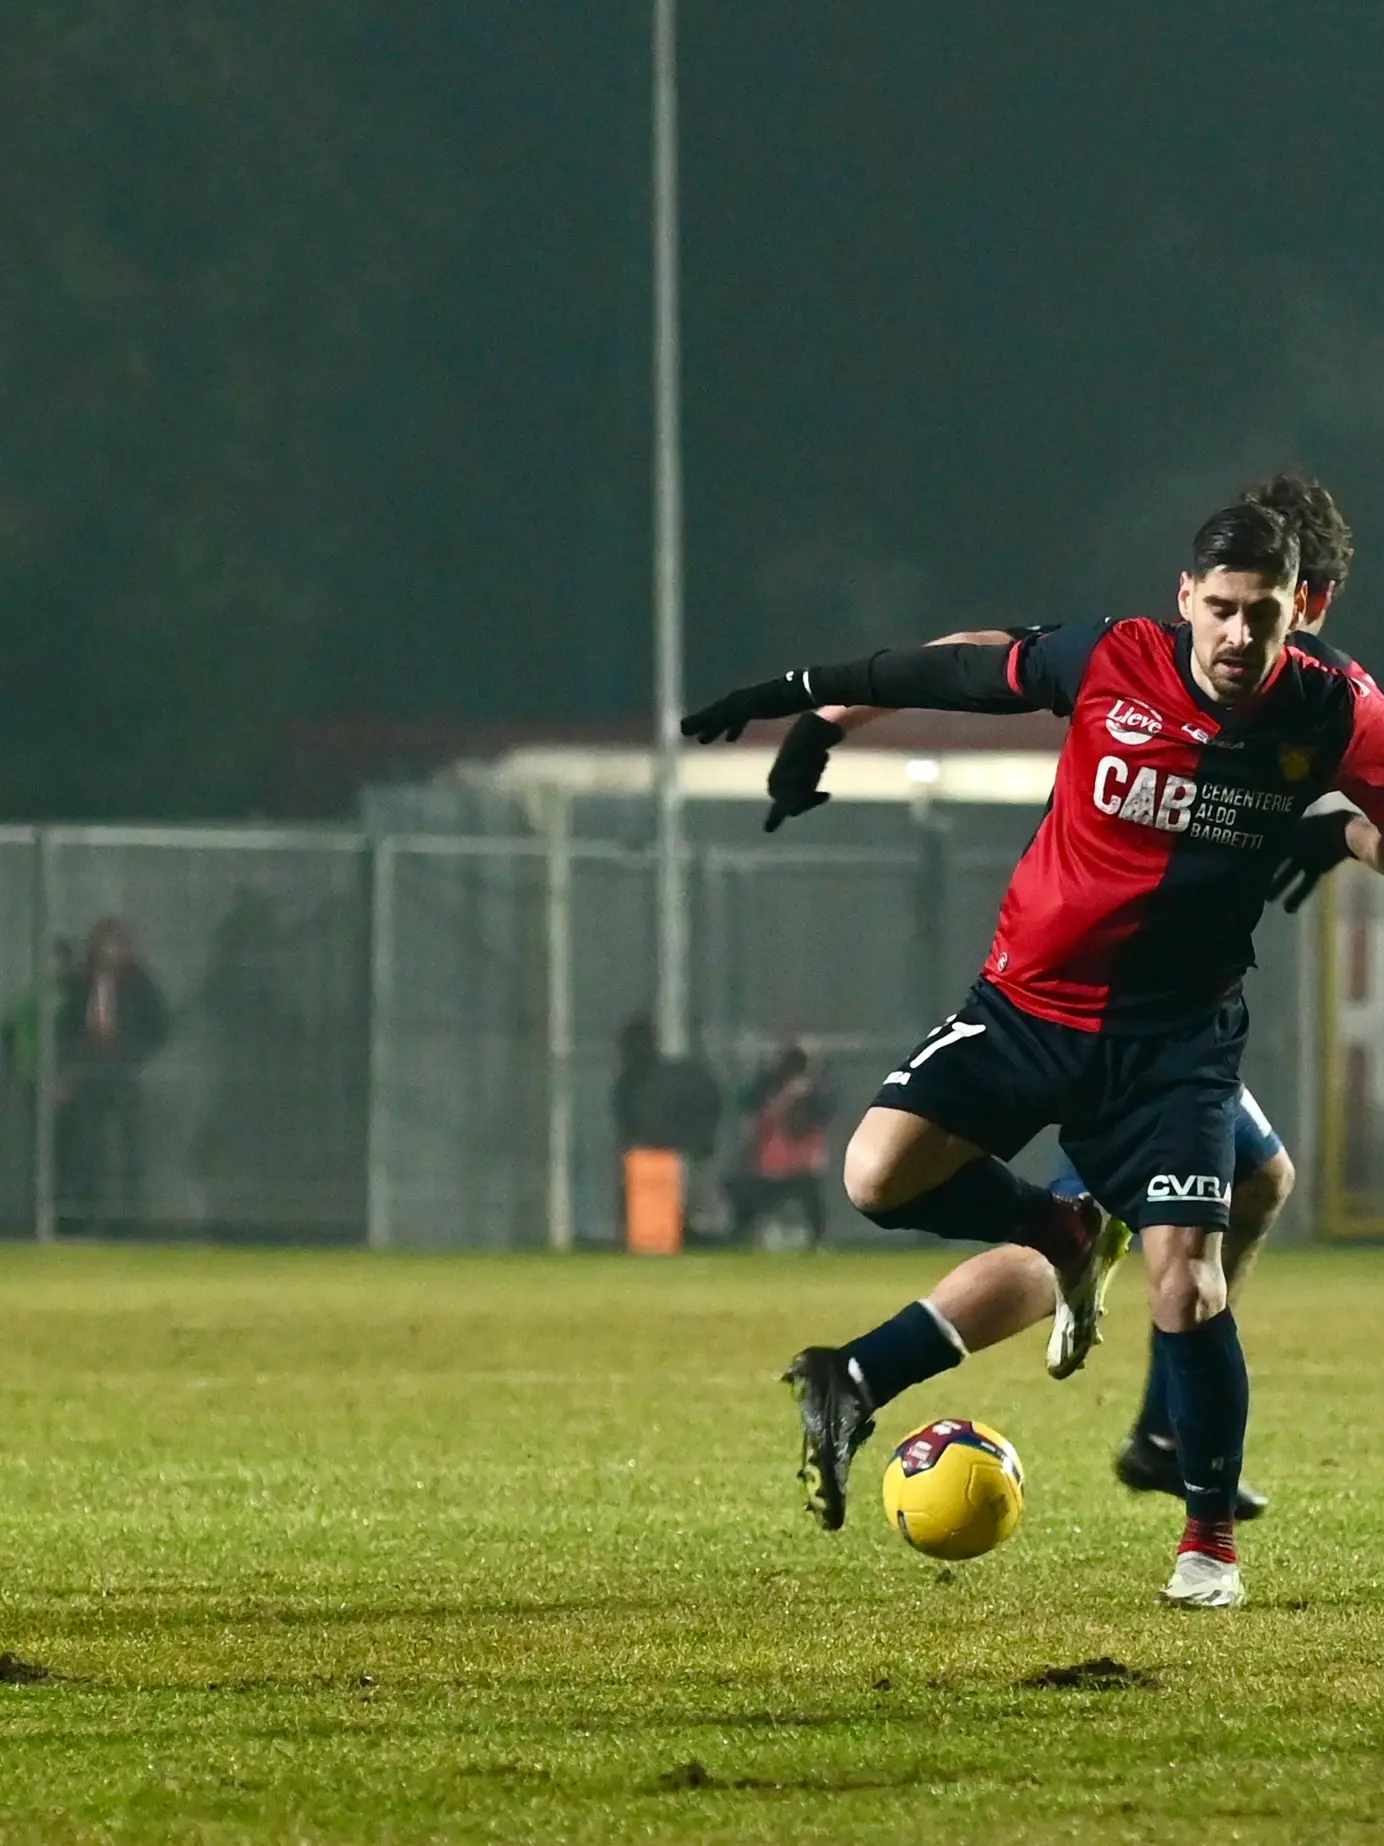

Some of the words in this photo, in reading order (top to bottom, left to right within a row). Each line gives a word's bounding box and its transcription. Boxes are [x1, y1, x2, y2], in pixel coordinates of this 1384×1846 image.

[1106, 699, 1163, 734] Lieve
[1092, 755, 1198, 833] CAB
[1201, 782, 1295, 813] CEMENTERIE
[1194, 802, 1237, 826] ALDO
[1190, 822, 1265, 850] BARBETTI
